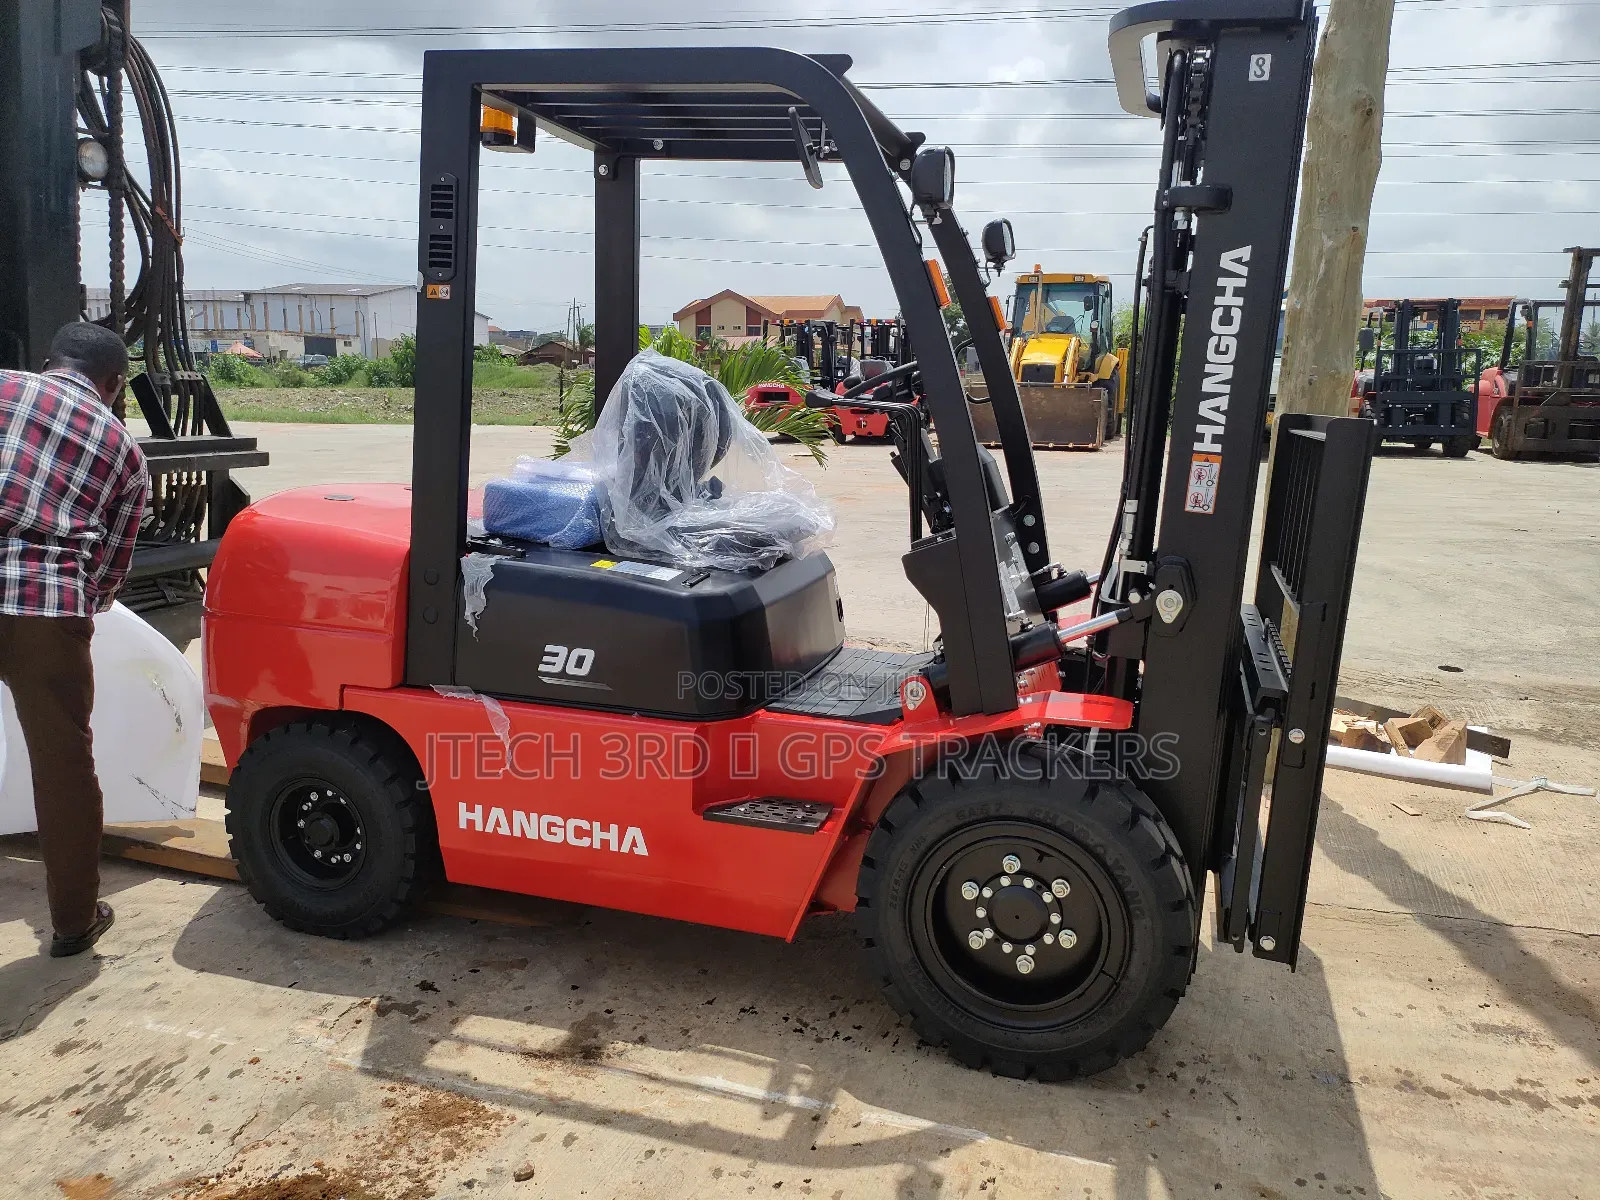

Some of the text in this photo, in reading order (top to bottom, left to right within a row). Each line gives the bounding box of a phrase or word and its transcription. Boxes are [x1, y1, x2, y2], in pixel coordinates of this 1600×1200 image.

[1193, 244, 1252, 453] HANGCHA
[537, 644, 595, 676] 30
[458, 801, 649, 856] HANGCHA
